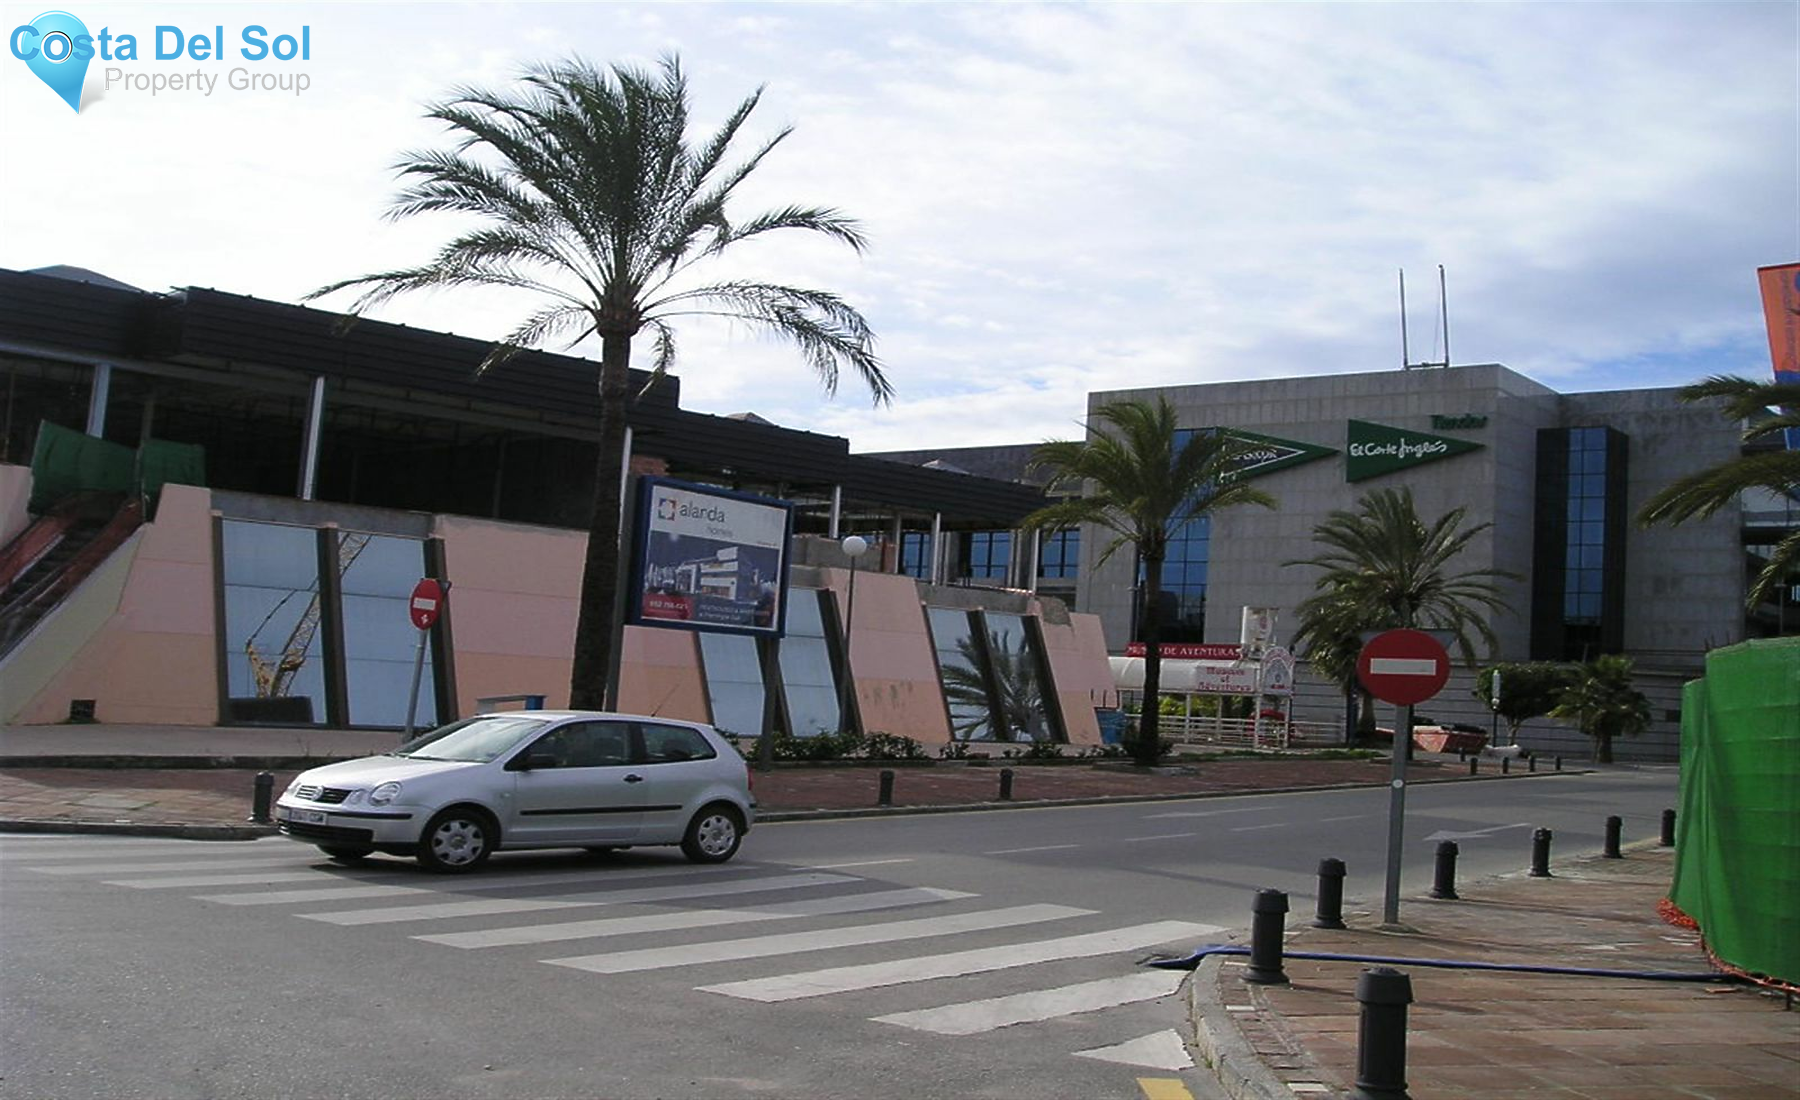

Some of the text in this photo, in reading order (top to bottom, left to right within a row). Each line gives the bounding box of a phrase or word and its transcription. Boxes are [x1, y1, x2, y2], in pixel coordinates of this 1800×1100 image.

[1350, 443, 1365, 456] El
[1365, 443, 1397, 456] Corte
[1164, 647, 1176, 655] DE
